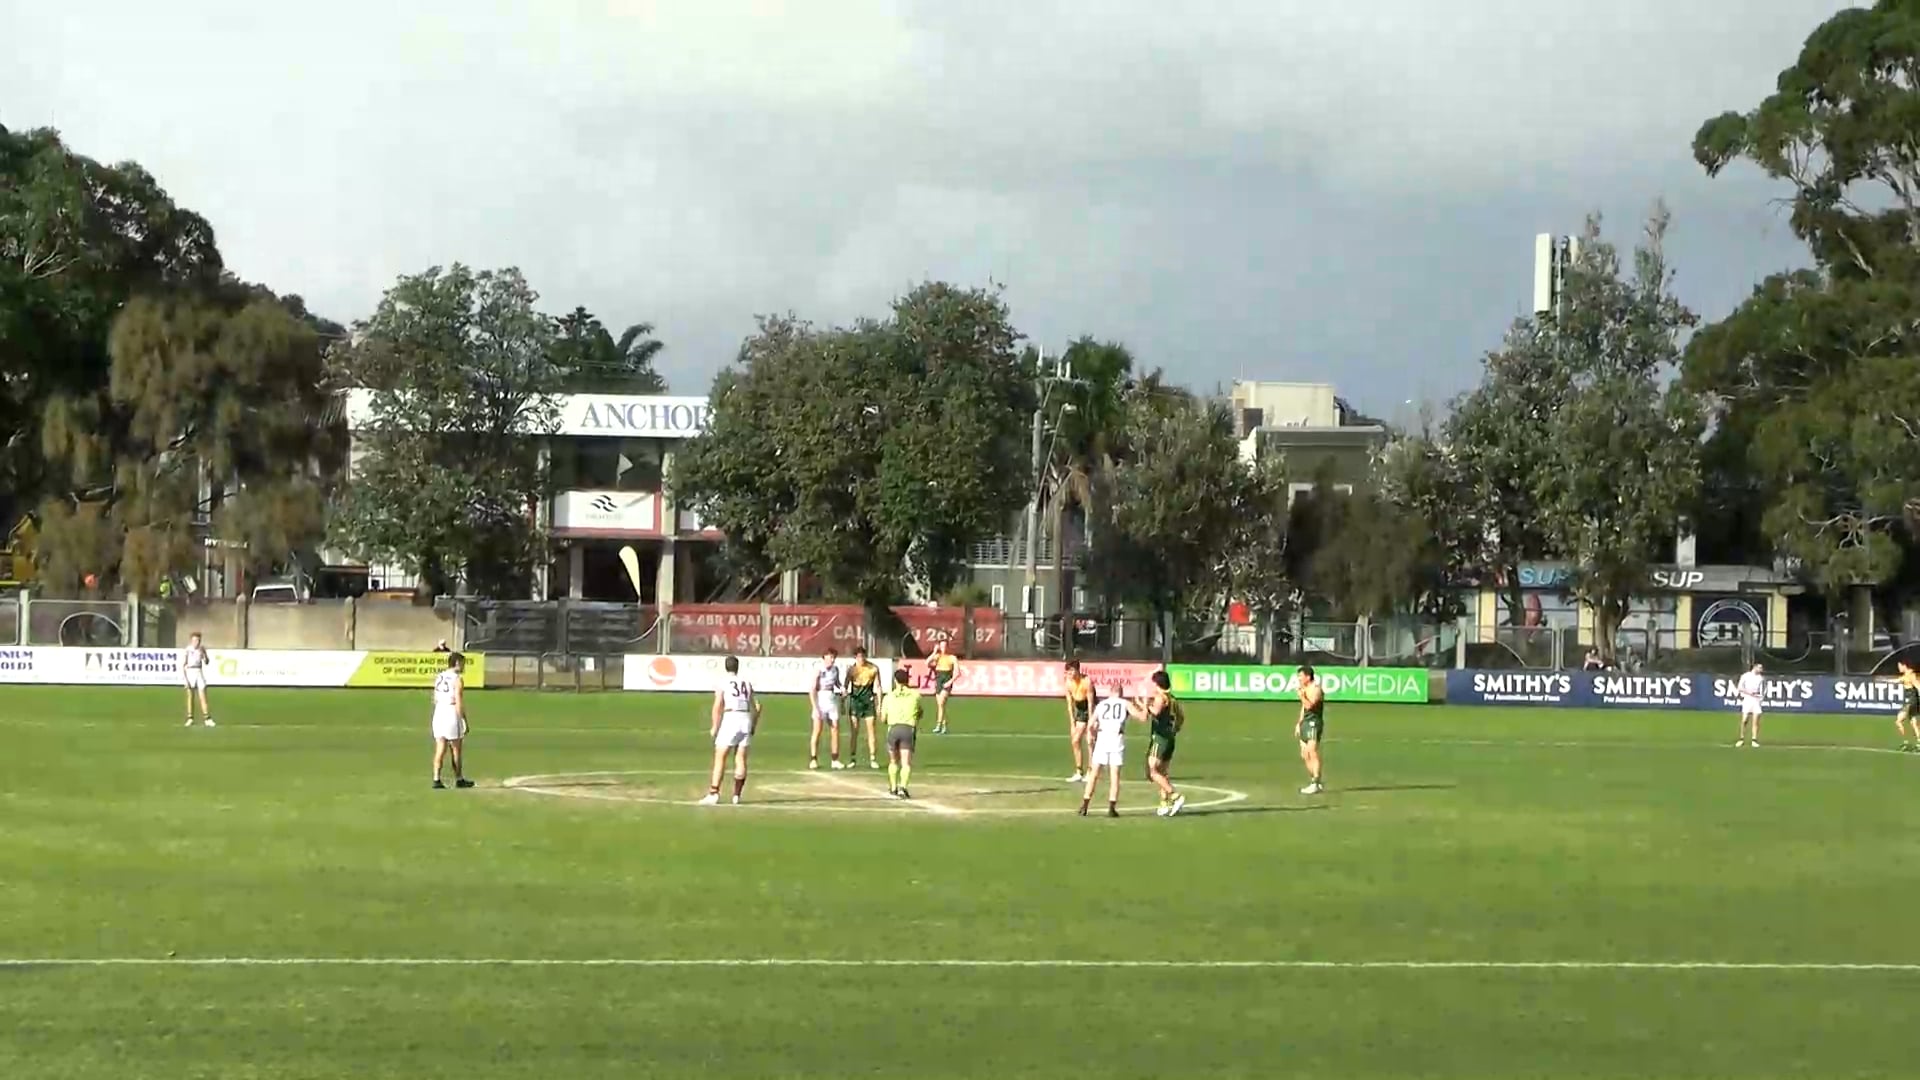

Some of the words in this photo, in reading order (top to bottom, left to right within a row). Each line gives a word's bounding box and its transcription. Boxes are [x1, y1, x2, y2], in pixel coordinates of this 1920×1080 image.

[1653, 571, 1704, 588] SUP
[727, 614, 819, 627] APATMENTS
[736, 634, 802, 650] $99K
[436, 675, 450, 693] 25
[730, 680, 749, 700] 34
[1473, 674, 1571, 694] SMITHY'S
[1593, 676, 1691, 696] SMITHY'S
[1713, 679, 1813, 699] SMHY'S
[1102, 702, 1122, 720] 20
